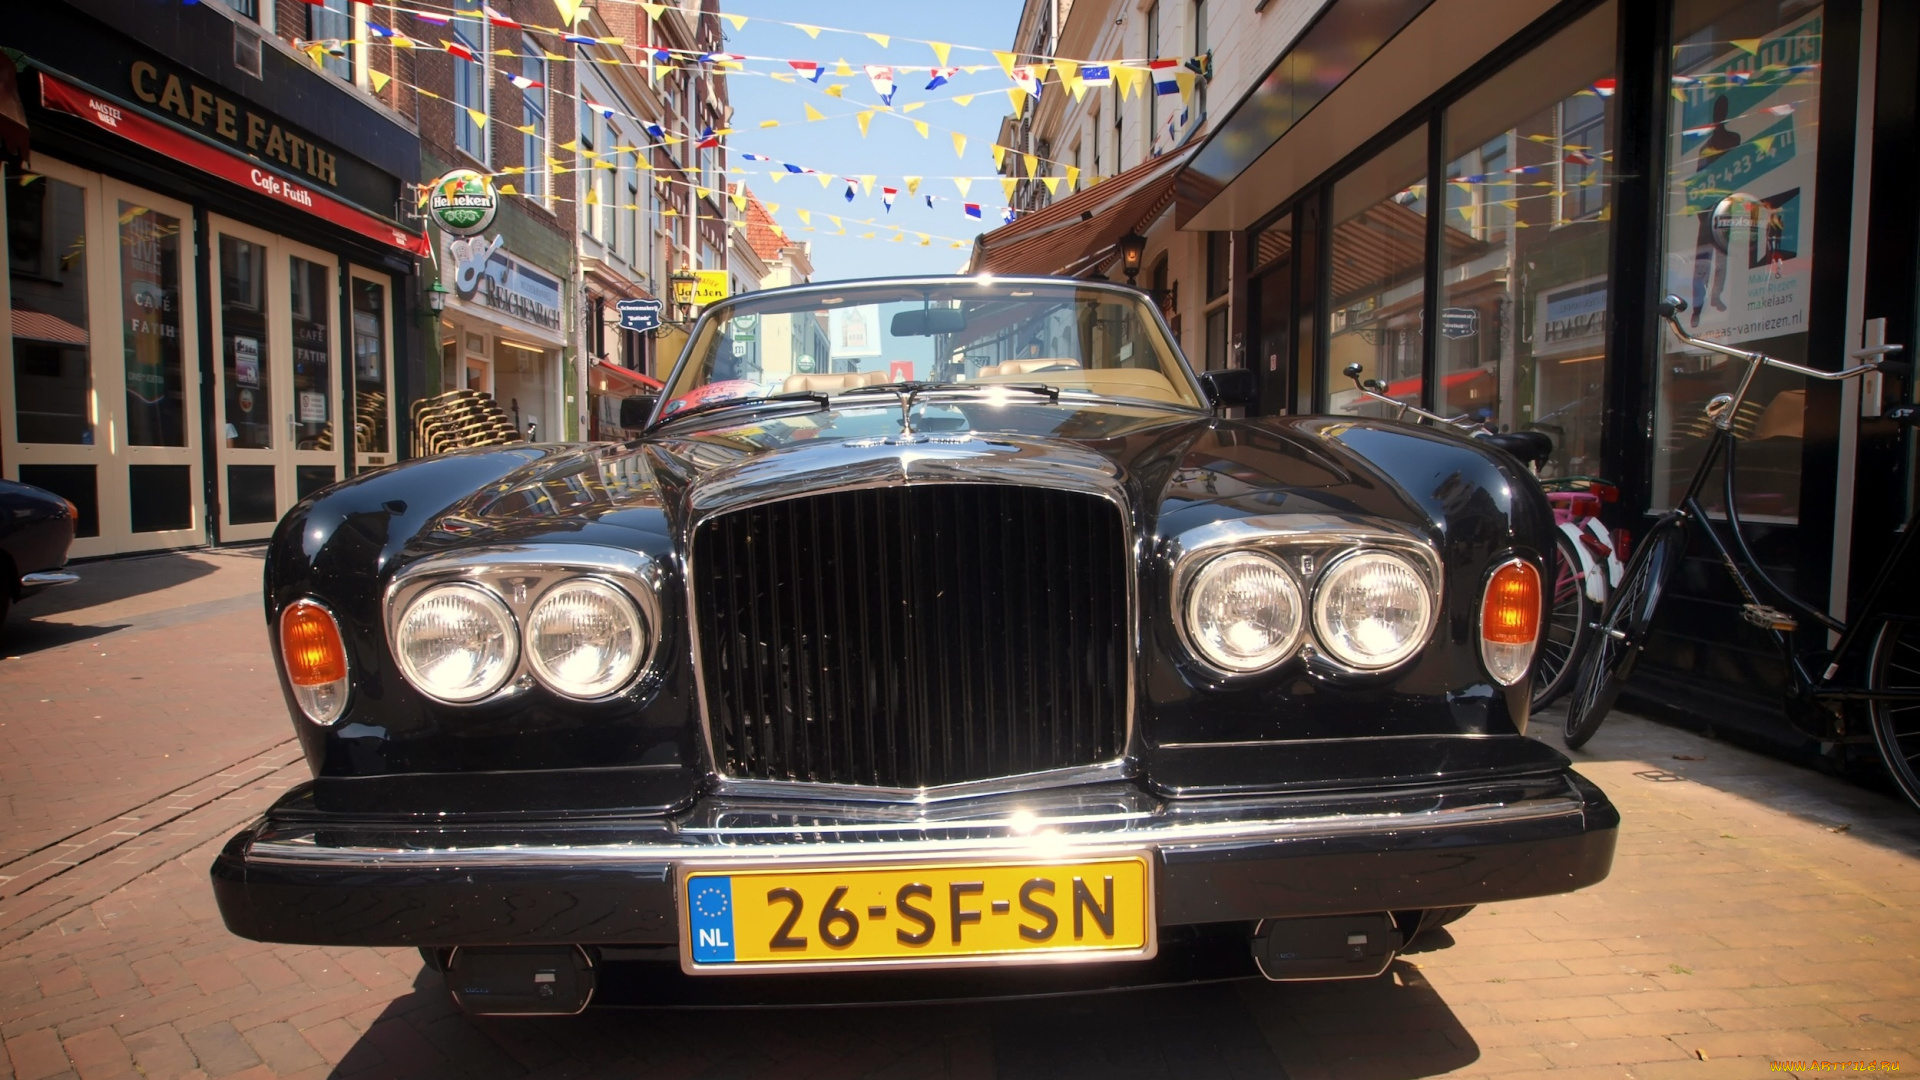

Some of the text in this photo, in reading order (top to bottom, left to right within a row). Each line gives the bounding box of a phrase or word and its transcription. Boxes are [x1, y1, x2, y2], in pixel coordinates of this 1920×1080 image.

[1725, 29, 1813, 91] HUUR
[89, 98, 123, 121] AMSTEL
[97, 111, 118, 128] BIER
[131, 60, 338, 187] CAFE FATIH
[250, 168, 313, 208] Cafe Fatih
[130, 235, 162, 266] LIVE
[1774, 266, 1782, 280] &
[486, 273, 561, 331] REICHENBACH
[1747, 293, 1793, 311] makelaars
[131, 318, 176, 338] FATIH
[297, 347, 327, 363] FATIH
[766, 874, 1116, 950] 26-SF-SN
[699, 927, 729, 948] NL
